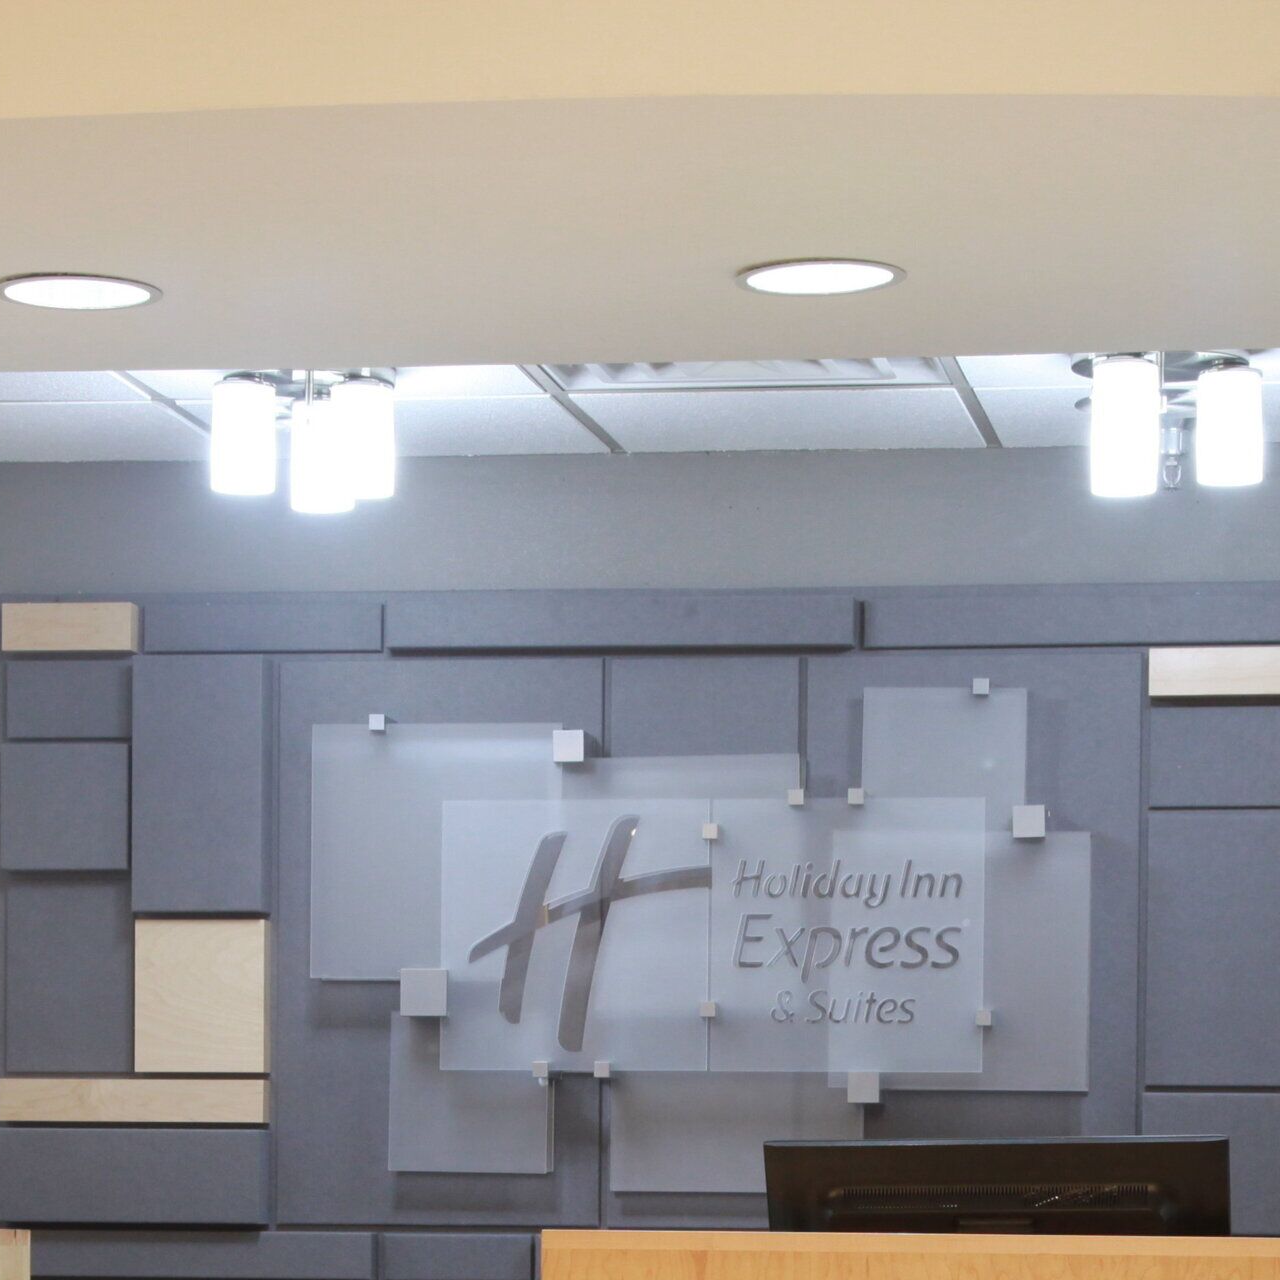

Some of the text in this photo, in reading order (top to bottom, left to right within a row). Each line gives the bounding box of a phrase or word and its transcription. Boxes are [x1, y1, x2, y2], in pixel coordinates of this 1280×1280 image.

[730, 859, 963, 908] Holiday Inn
[732, 913, 962, 984] Express
[771, 990, 916, 1024] & Suites
